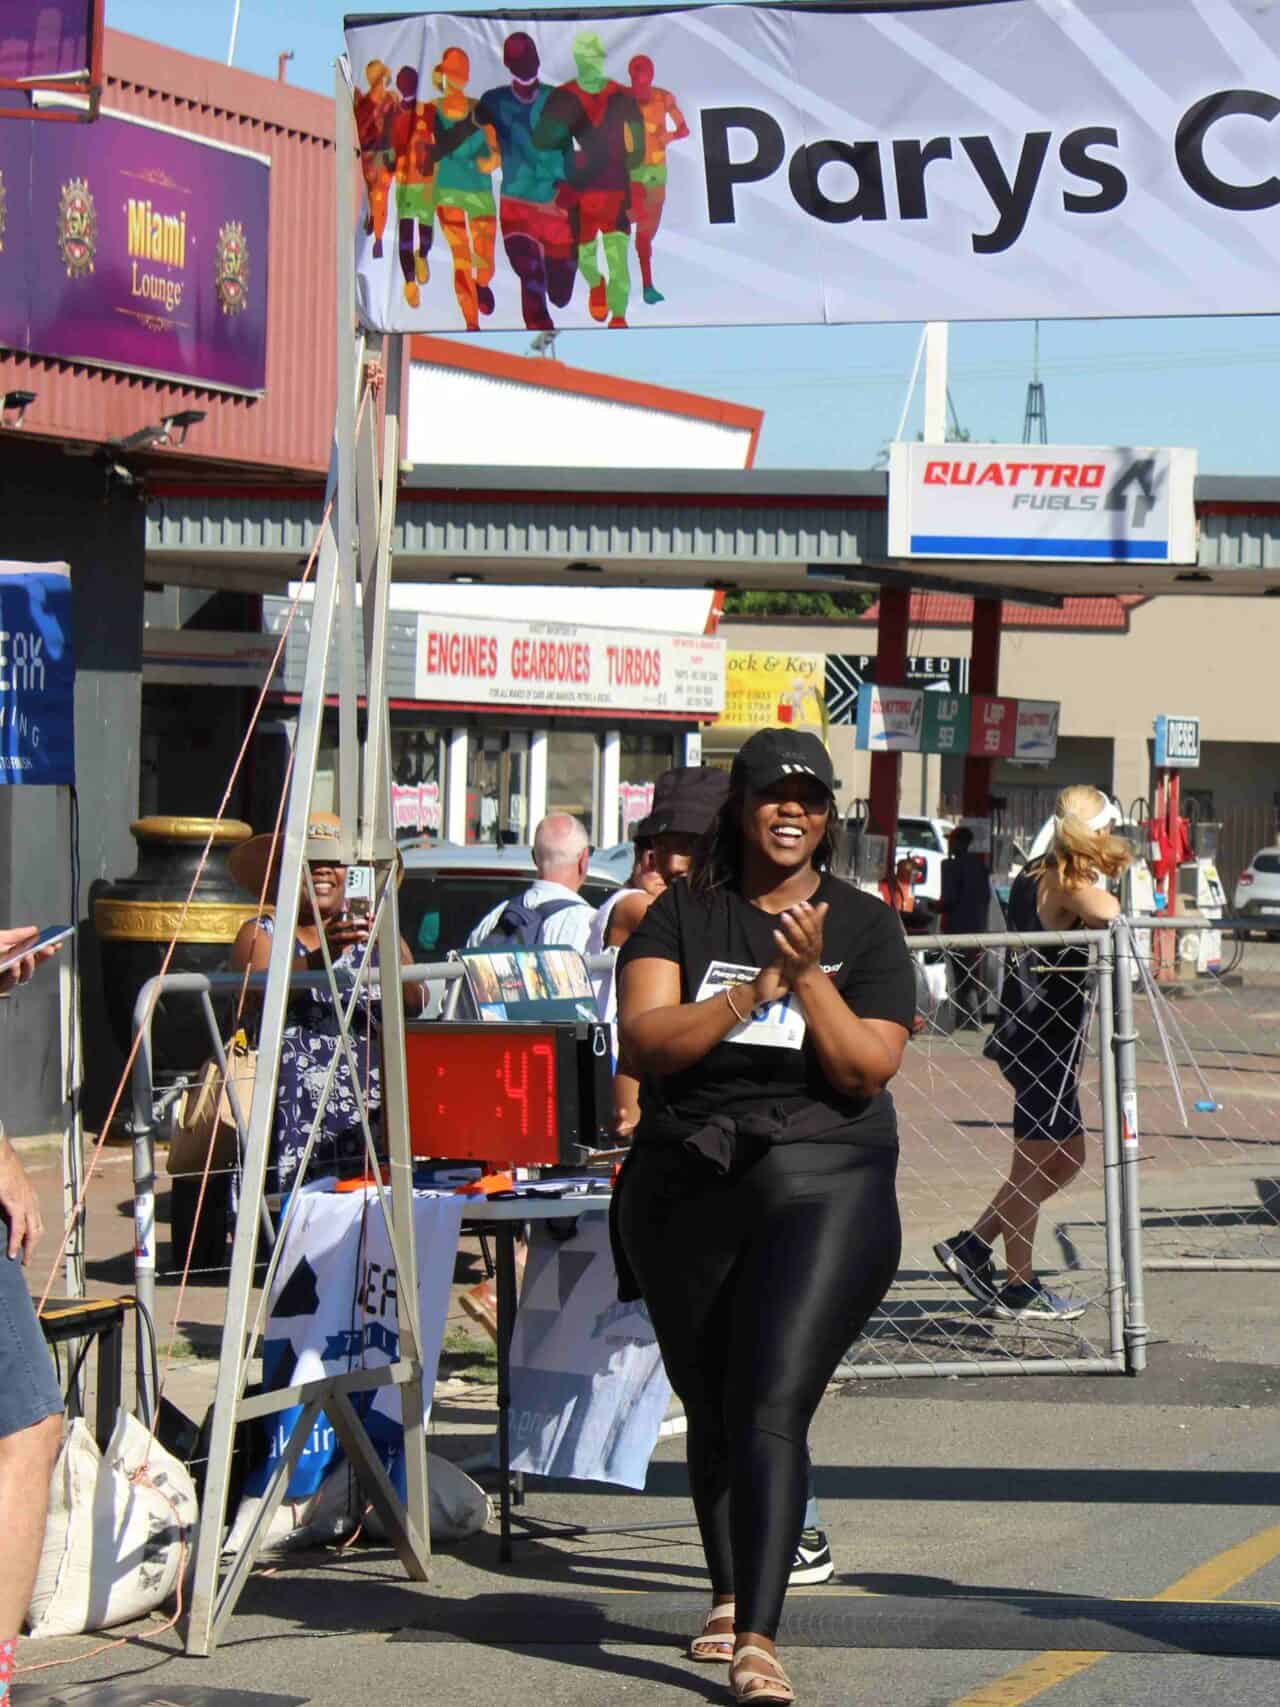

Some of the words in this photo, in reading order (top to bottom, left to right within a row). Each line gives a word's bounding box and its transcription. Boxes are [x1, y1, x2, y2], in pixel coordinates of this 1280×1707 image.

[700, 106, 1128, 254] Parys
[127, 197, 187, 269] Miami
[131, 260, 184, 312] Lounge
[923, 461, 1106, 489] QUATTRO
[1012, 494, 1100, 512] FUELS
[427, 631, 498, 679] ENGINES
[511, 638, 591, 684] GEARBOXES
[606, 645, 661, 688] TURBOS
